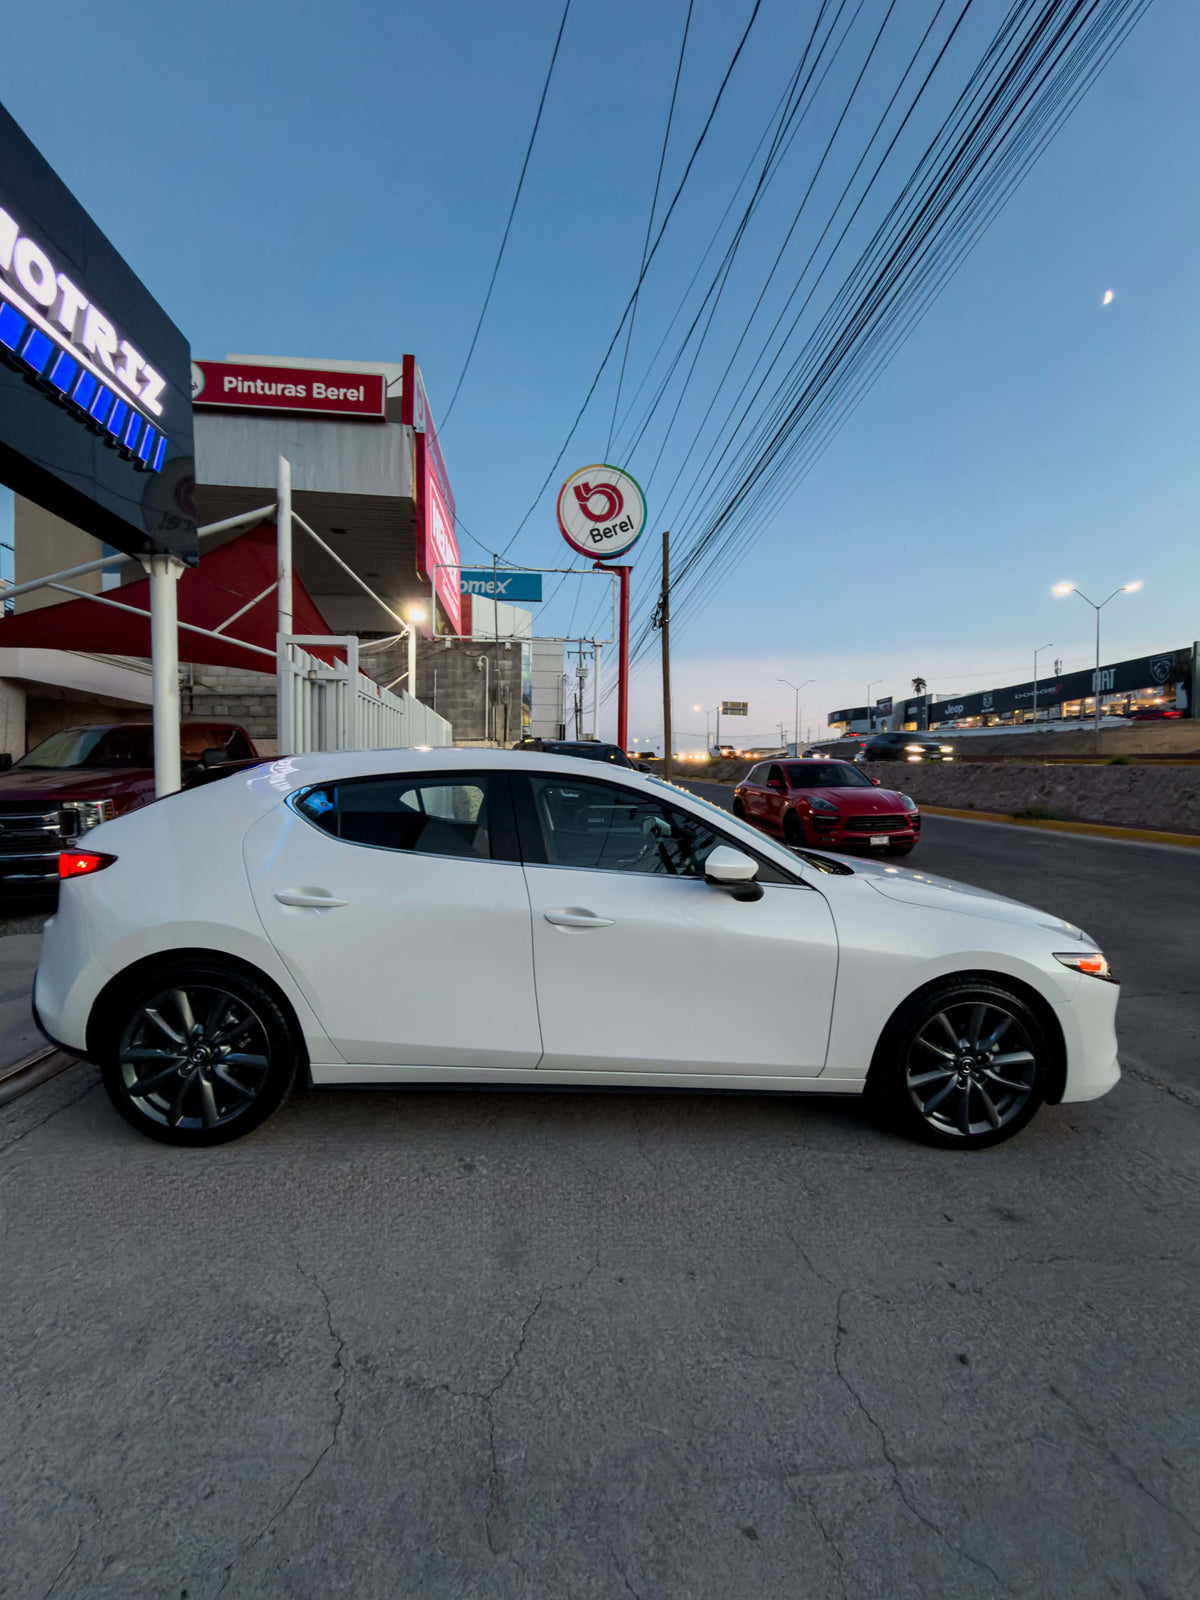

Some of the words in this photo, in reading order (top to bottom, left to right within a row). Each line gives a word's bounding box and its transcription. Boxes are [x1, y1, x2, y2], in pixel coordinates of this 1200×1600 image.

[223, 376, 306, 398] Pinturas
[313, 382, 364, 402] Berel
[589, 515, 635, 544] Berel
[944, 704, 964, 715] Jeep
